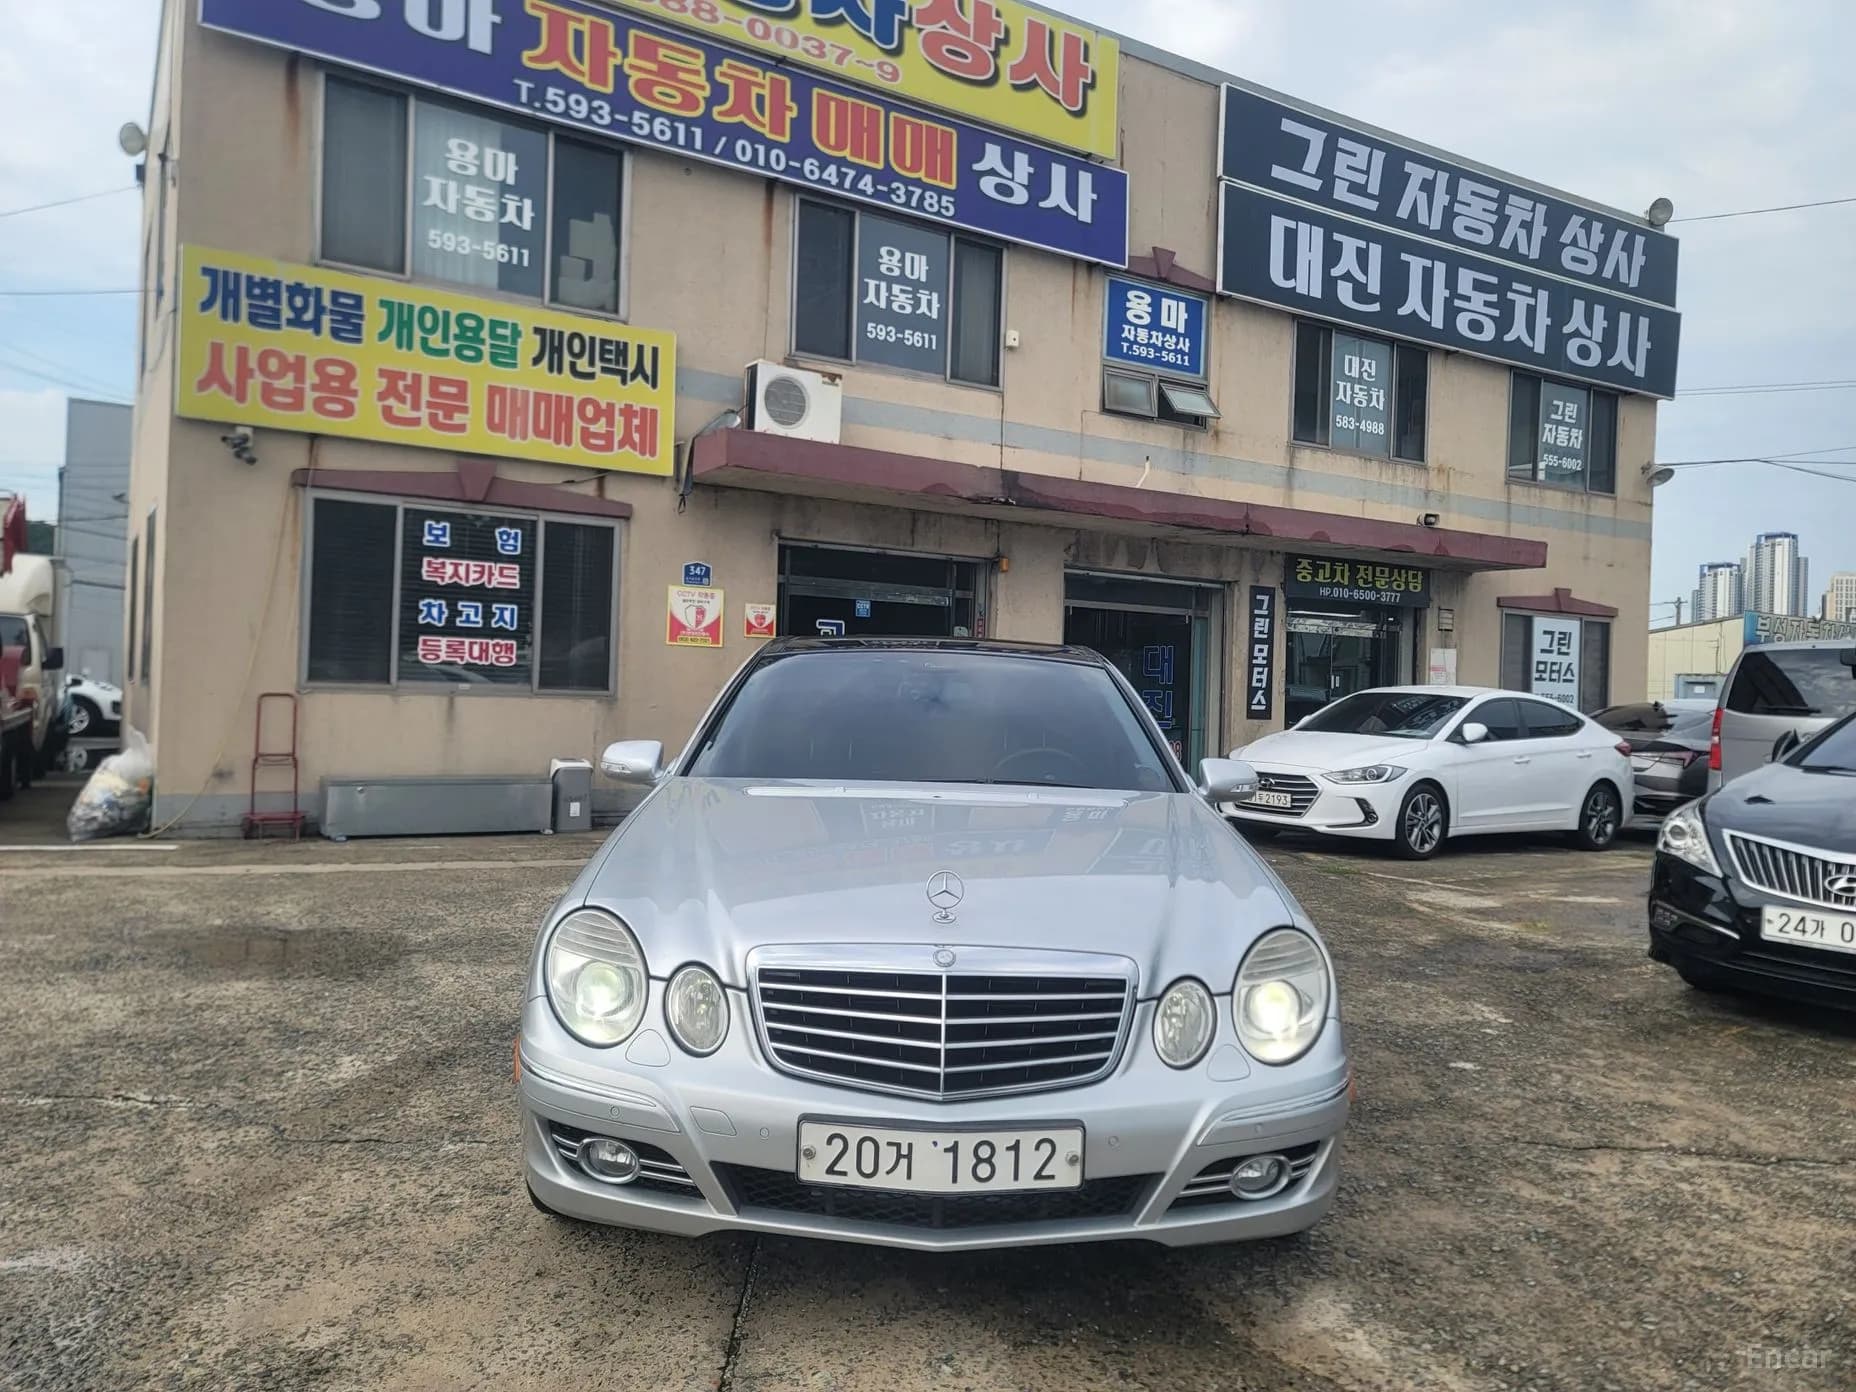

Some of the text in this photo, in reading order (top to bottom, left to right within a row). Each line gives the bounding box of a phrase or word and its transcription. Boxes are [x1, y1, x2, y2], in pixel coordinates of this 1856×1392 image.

[523, 0, 798, 143] 자동차
[812, 88, 957, 190] 매매
[972, 143, 1098, 223] 상사
[444, 138, 519, 186] 용마
[513, 79, 703, 150] T.593-5611
[735, 139, 955, 218] 010-6474-3785
[423, 175, 536, 231] 자동차
[1271, 118, 1647, 288] 그린 자동차 상사
[428, 229, 530, 267] 593-5611
[878, 246, 929, 282] 용마
[863, 278, 941, 320] 자동차
[1270, 215, 1652, 377] 대진 자동차 상사
[1126, 290, 1188, 333] 용마
[199, 266, 660, 390] 개별화물 개인용달 개인택시
[866, 322, 937, 350] 593-5611
[1121, 324, 1190, 353] 자동차상사
[1121, 342, 1190, 366] T.593-5611
[1344, 354, 1376, 381] 대진
[196, 341, 658, 459] 사업용 전문 매매업체
[1336, 381, 1385, 411] 자동차
[1335, 415, 1385, 435] 583-4988
[1550, 400, 1578, 424] 그린
[1542, 423, 1583, 449] 자동차
[1543, 454, 1582, 471] 555-6002
[422, 557, 519, 589] 복지카드
[689, 565, 706, 576] 347
[1295, 558, 1423, 593] 중고차 전문상담
[1319, 586, 1401, 603] HP.010-6500-3777
[418, 636, 517, 666] 등록대행
[1540, 630, 1572, 656] 그린
[1534, 660, 1574, 683] 모터스
[1265, 794, 1288, 806] 2193
[1777, 912, 1826, 939] 24가
[825, 1133, 1057, 1184] 20거 1812
